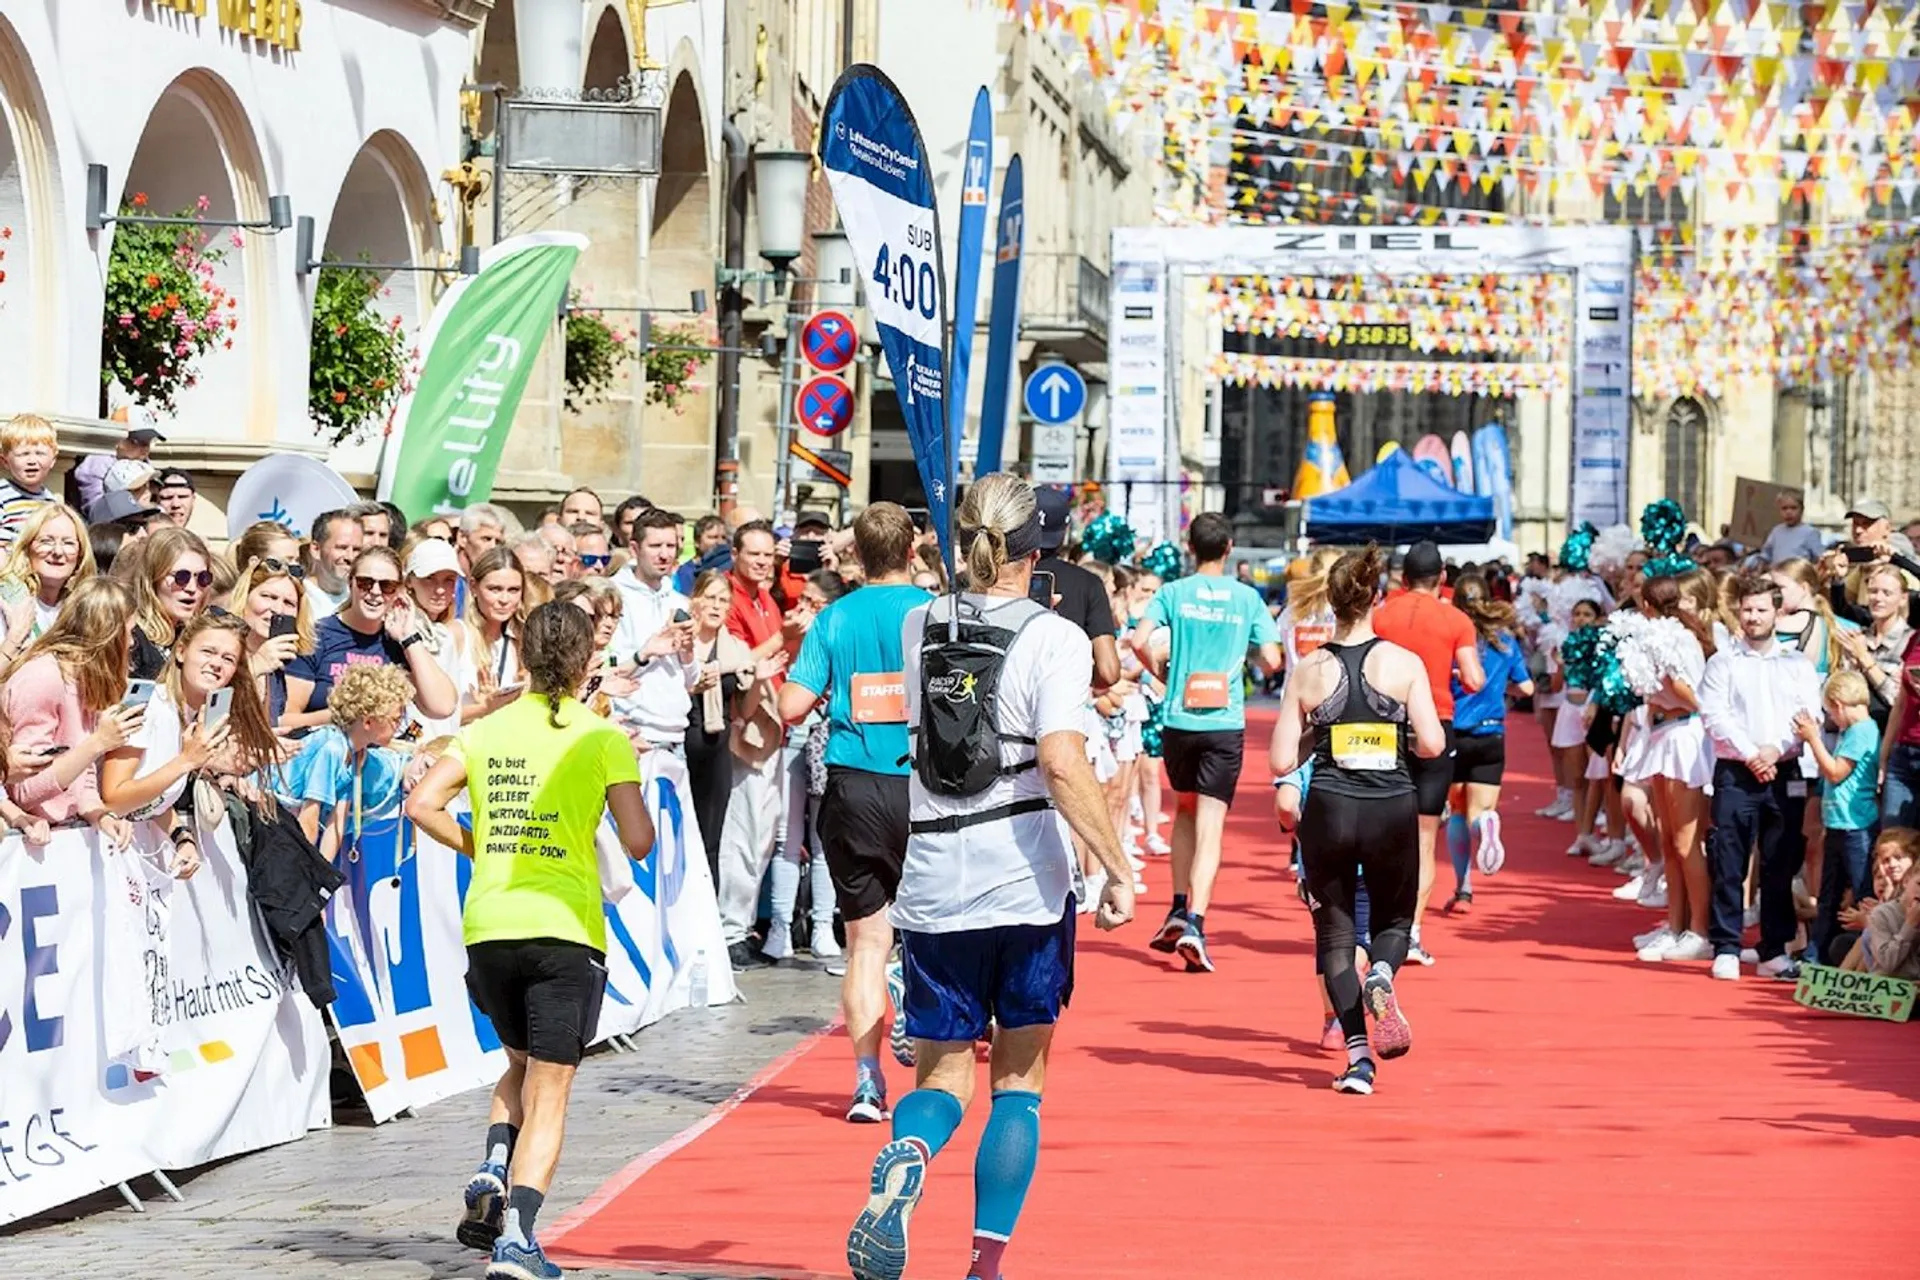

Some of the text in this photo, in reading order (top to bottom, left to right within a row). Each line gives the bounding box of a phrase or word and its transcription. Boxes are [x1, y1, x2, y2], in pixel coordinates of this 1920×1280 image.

[907, 224, 932, 251] SUB
[1273, 233, 1480, 250] ZIEL
[873, 242, 936, 320] 4:00
[861, 684, 905, 697] STAFFE
[1363, 735, 1381, 746] KM
[488, 757, 526, 769] Du bist
[539, 811, 559, 823] und
[486, 842, 518, 854] DANKE
[521, 843, 538, 855] für
[172, 975, 217, 1022] Haut
[216, 969, 254, 1013] mit
[1826, 988, 1846, 999] DU
[1809, 996, 1885, 1015] KRASS
